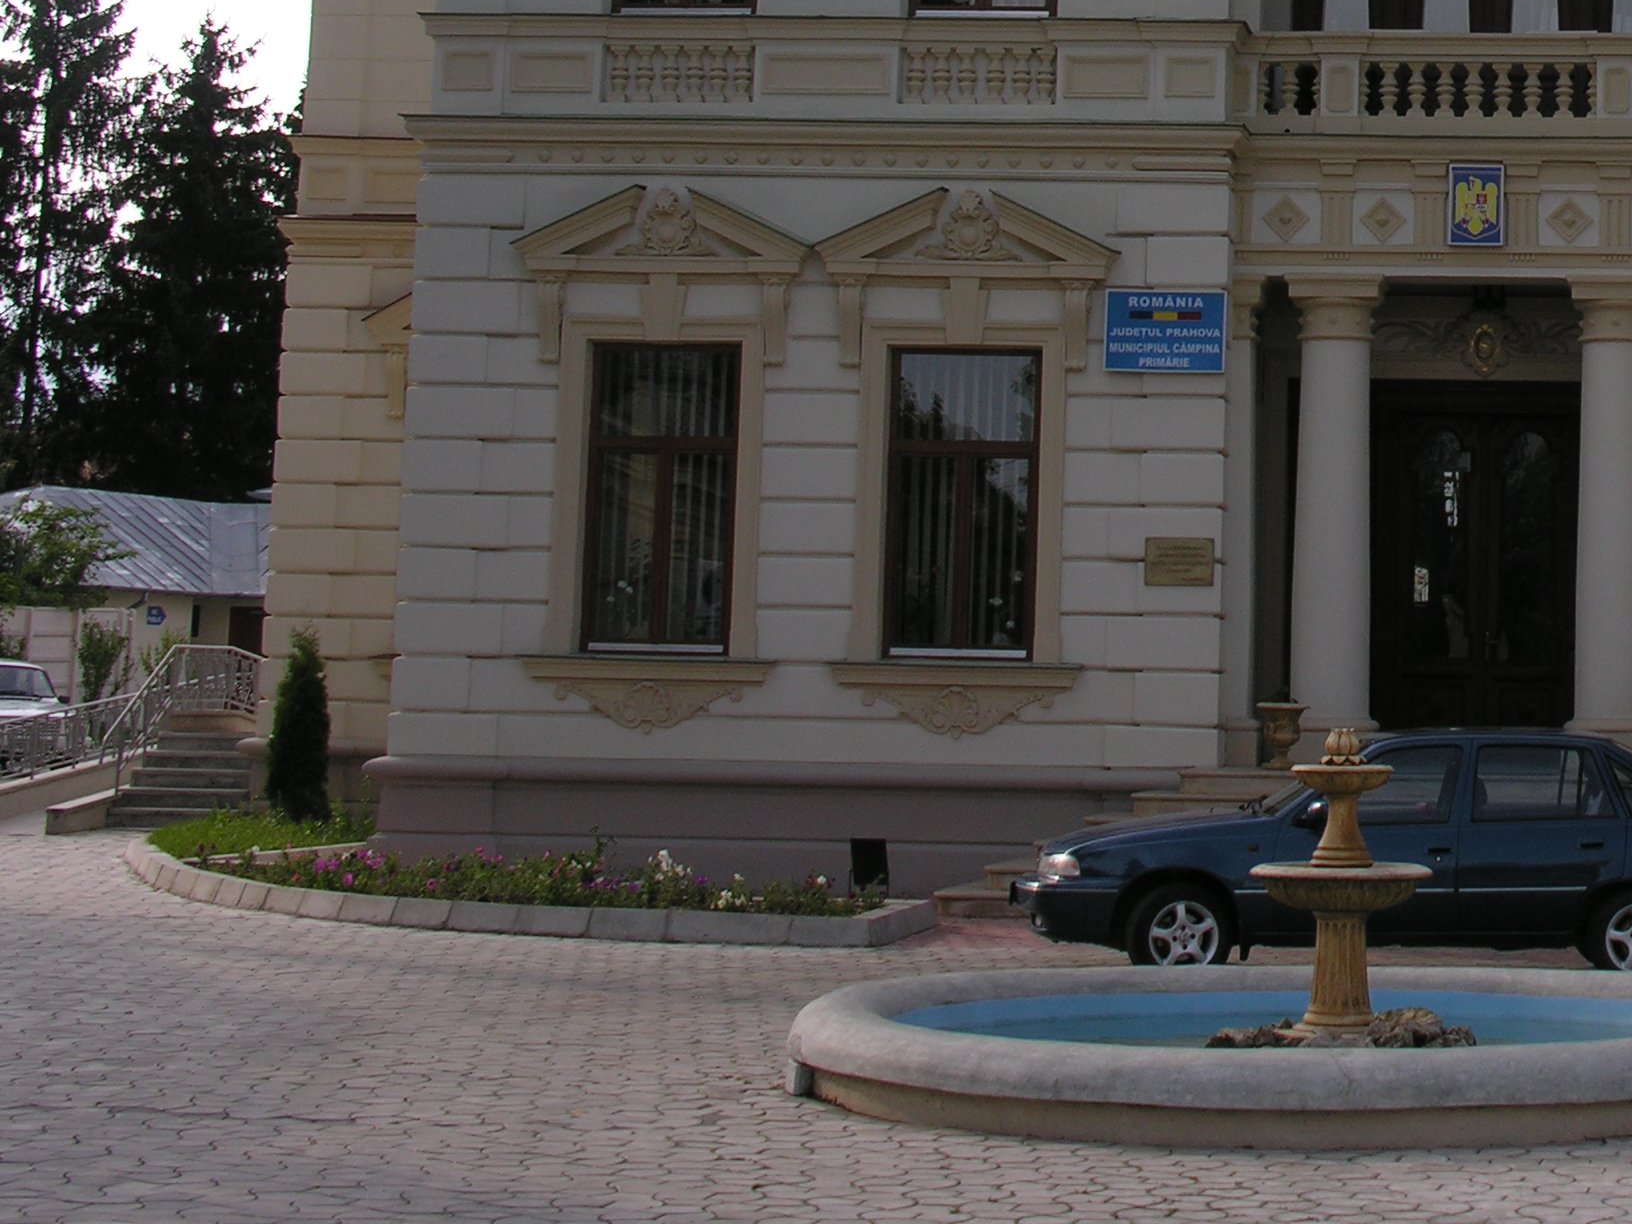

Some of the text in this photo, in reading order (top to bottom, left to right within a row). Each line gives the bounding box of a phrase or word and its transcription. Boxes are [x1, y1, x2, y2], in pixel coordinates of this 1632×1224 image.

[1128, 295, 1204, 308] ROMÂNIA
[1166, 328, 1221, 337] PRAHOVA
[1109, 342, 1220, 353] MUNICIPIUL CÂMPINA
